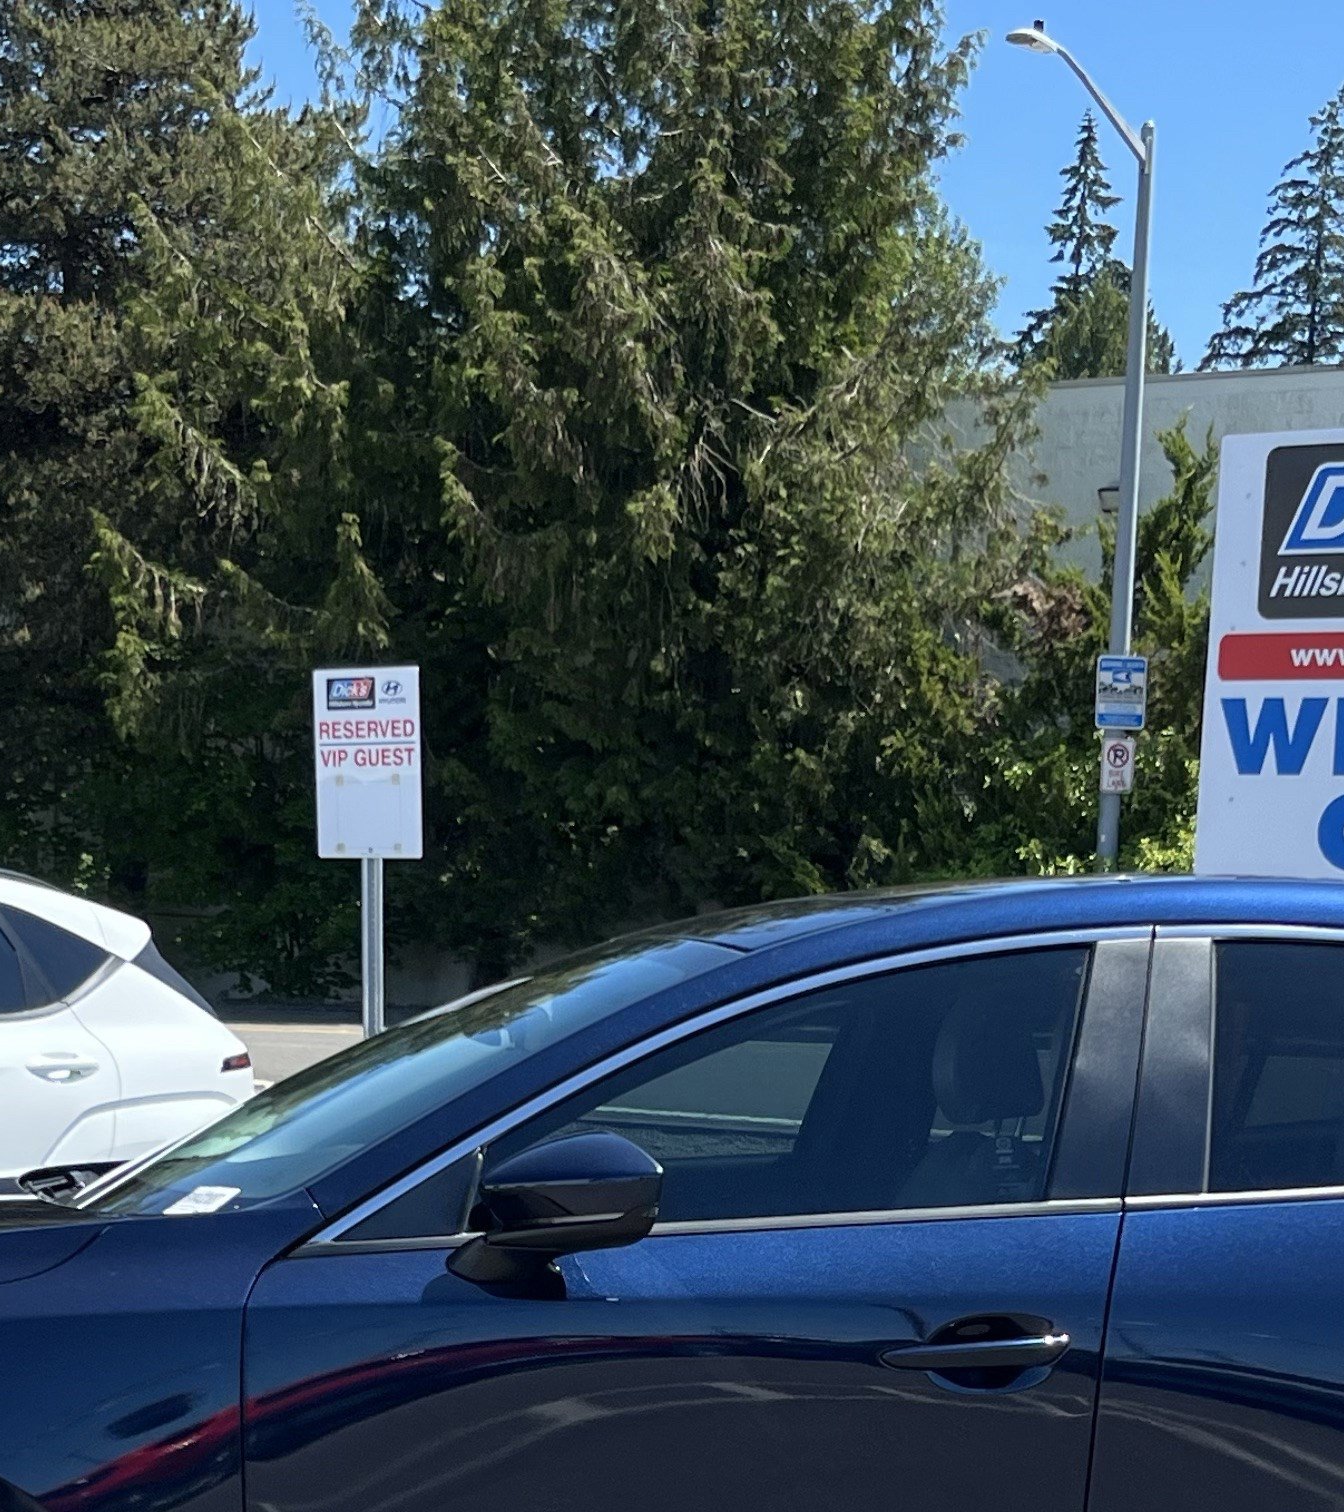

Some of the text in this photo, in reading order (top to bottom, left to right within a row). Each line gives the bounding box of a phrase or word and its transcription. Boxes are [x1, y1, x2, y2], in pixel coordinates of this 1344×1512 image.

[319, 719, 415, 739] RESERVED
[321, 748, 415, 768] VIP GUEST
